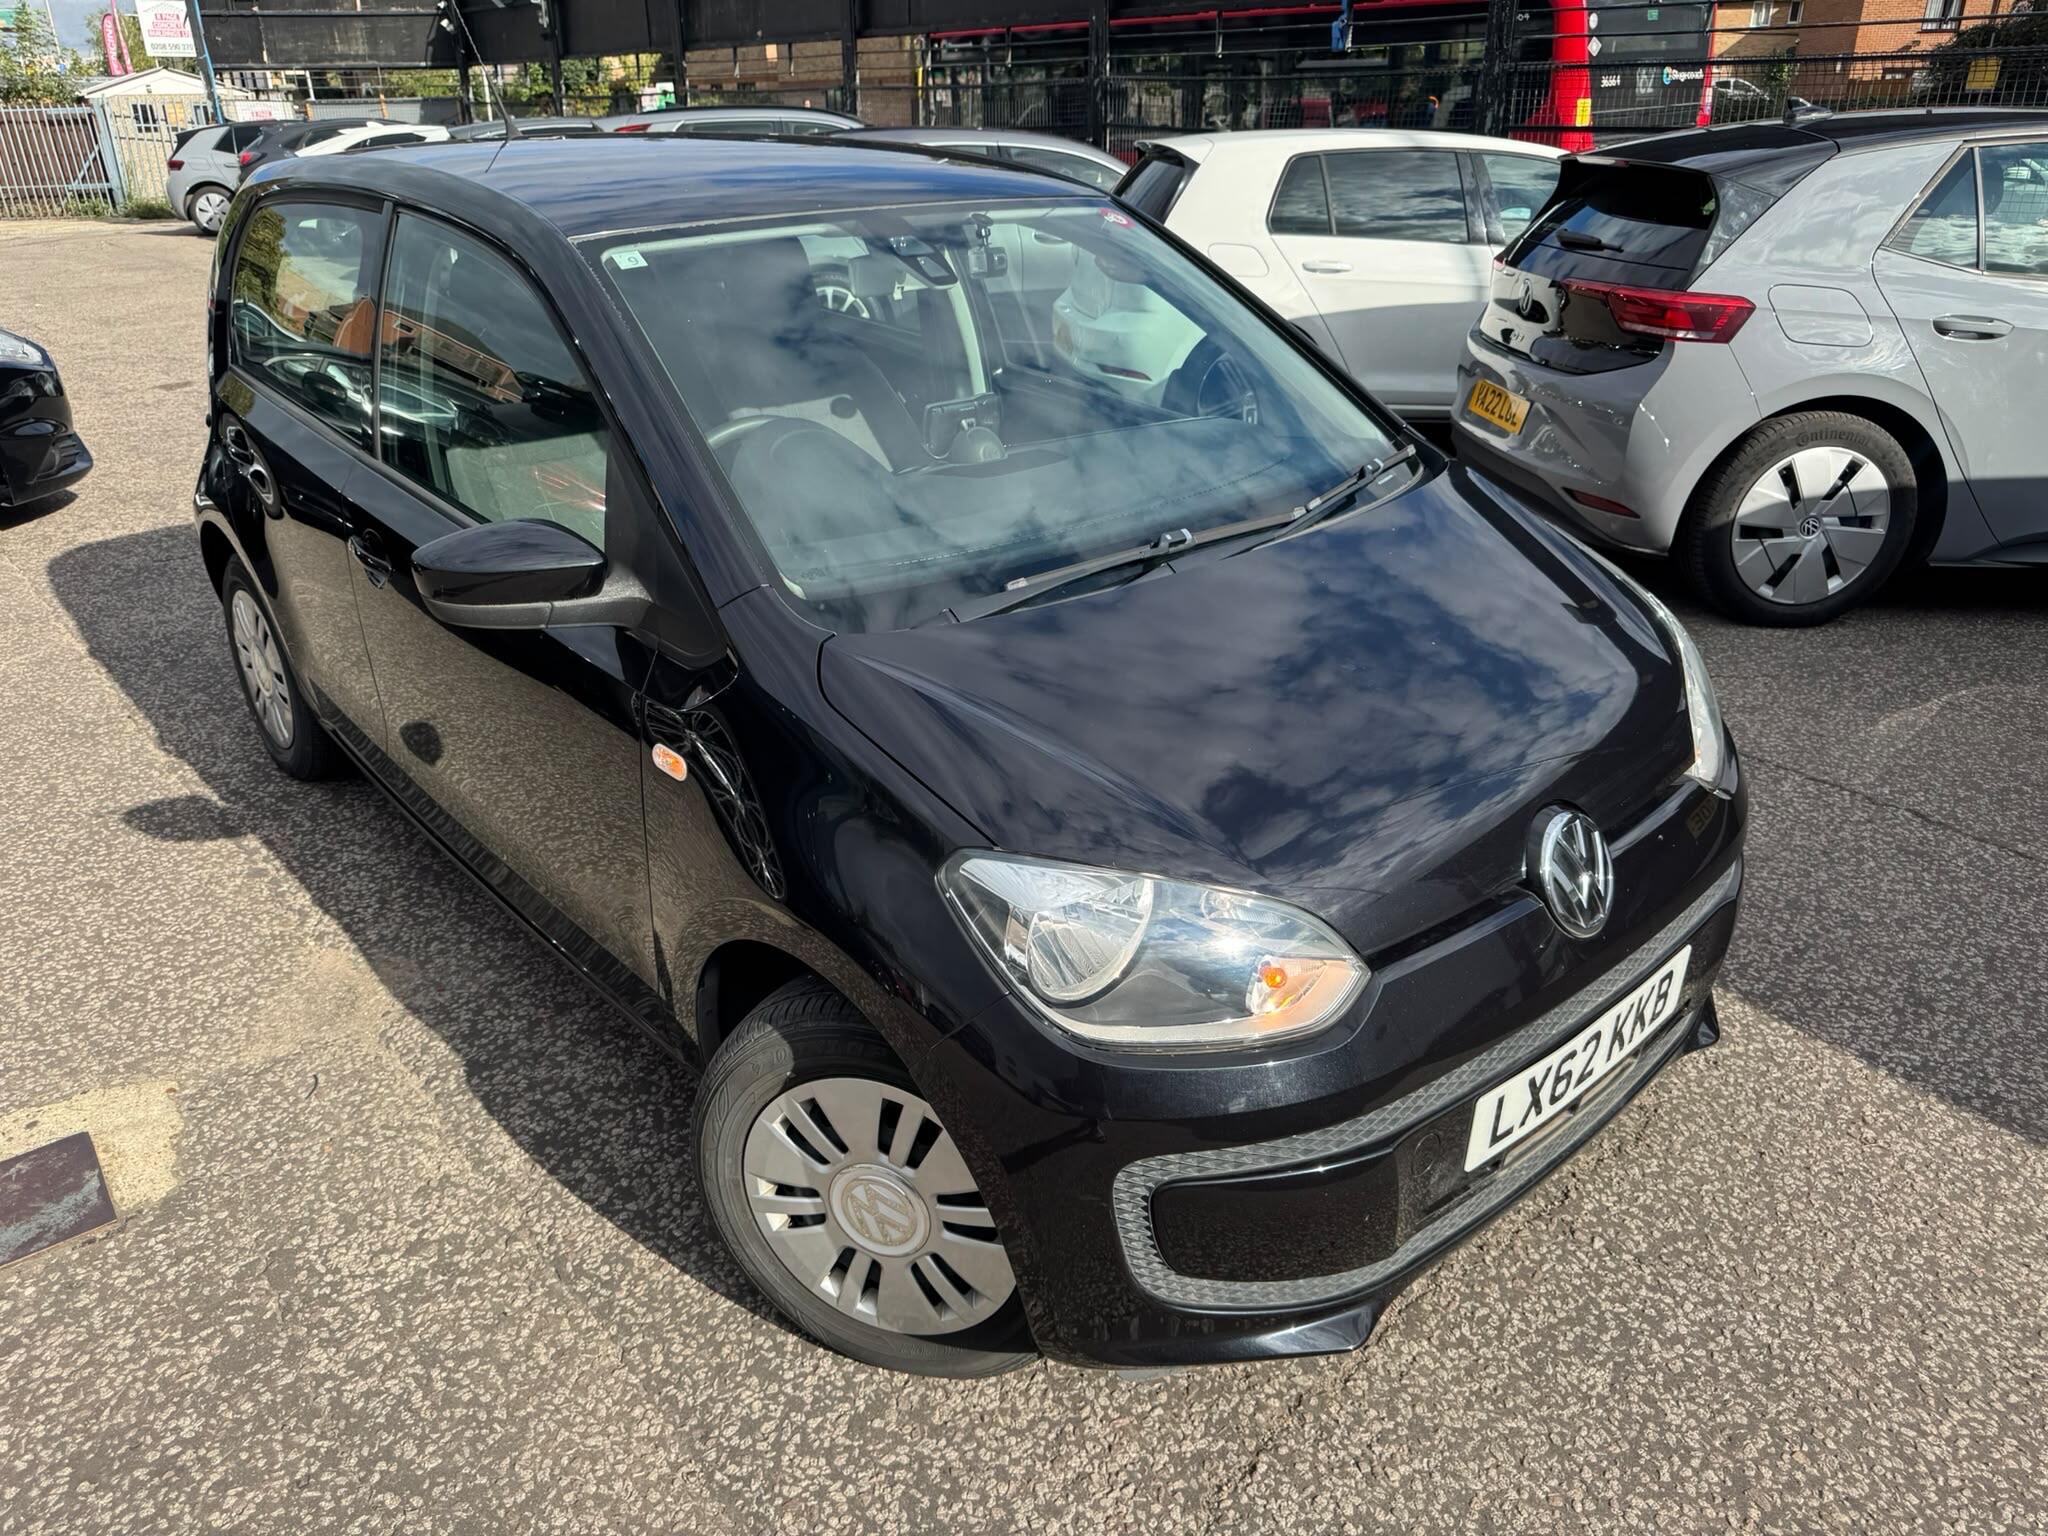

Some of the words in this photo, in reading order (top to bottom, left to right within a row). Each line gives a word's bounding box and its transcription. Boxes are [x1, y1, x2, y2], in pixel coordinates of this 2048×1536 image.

[1796, 428, 1870, 447] Continental
[1488, 1032, 1602, 1148] LX62
[1606, 969, 1674, 1064] KKB
